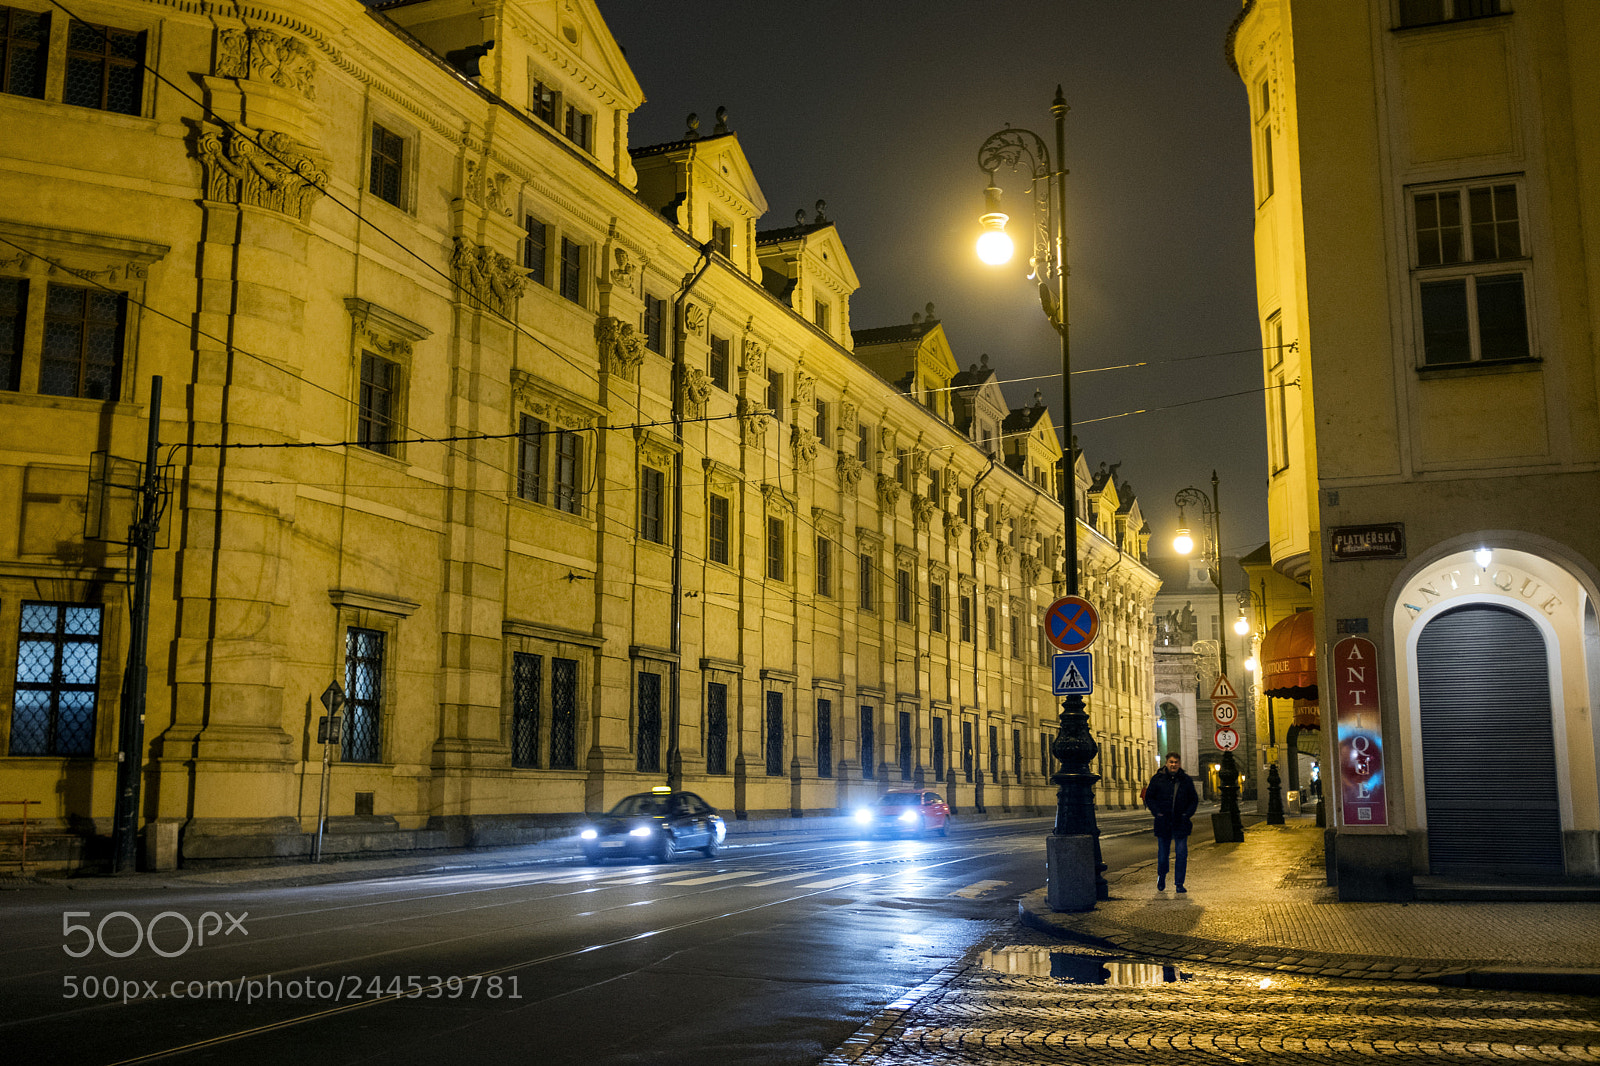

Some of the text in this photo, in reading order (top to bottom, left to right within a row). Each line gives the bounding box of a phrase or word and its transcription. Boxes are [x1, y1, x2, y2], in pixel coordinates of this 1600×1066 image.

[1403, 570, 1562, 620] ANTIQUE
[1218, 707, 1233, 719] 30
[1347, 643, 1371, 799] ANTIQUE
